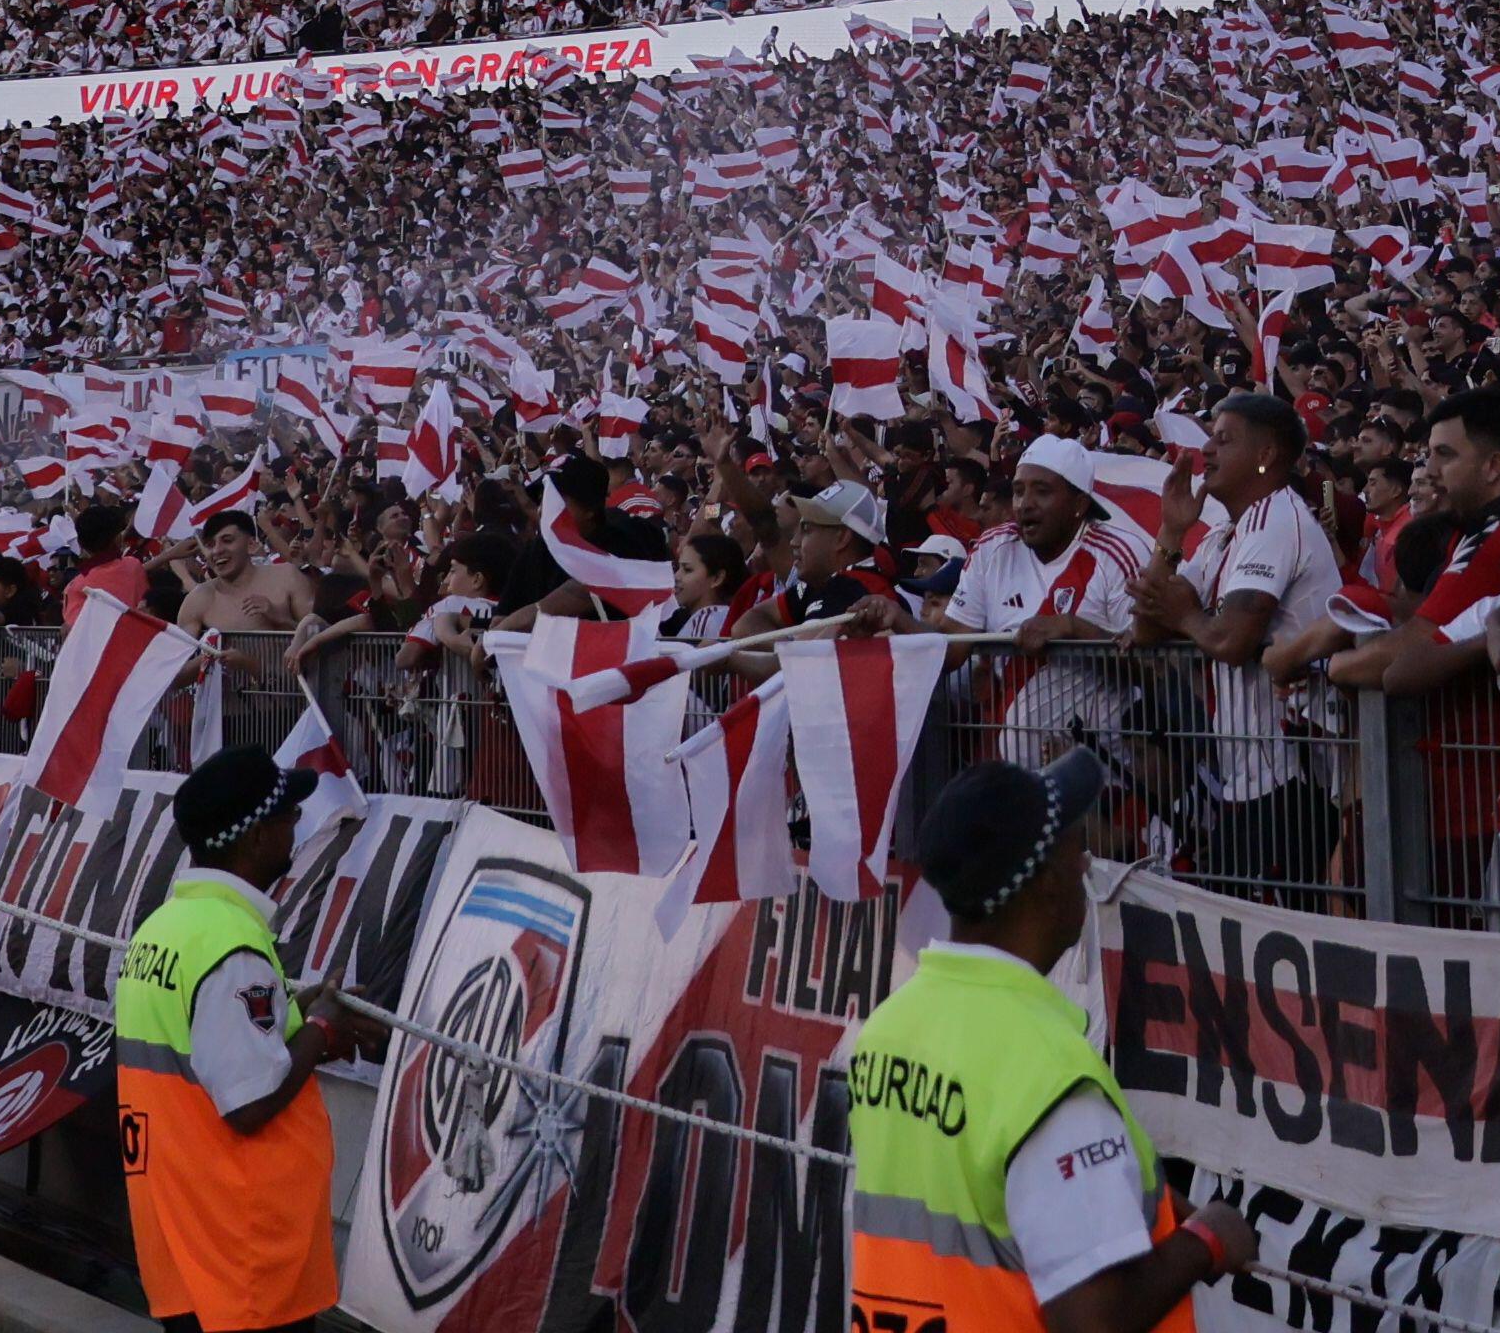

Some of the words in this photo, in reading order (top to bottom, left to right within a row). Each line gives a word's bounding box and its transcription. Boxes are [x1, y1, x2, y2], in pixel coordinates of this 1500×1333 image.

[80, 79, 179, 114] VIVIR
[192, 77, 217, 104] Y
[412, 1216, 445, 1254] 1901
